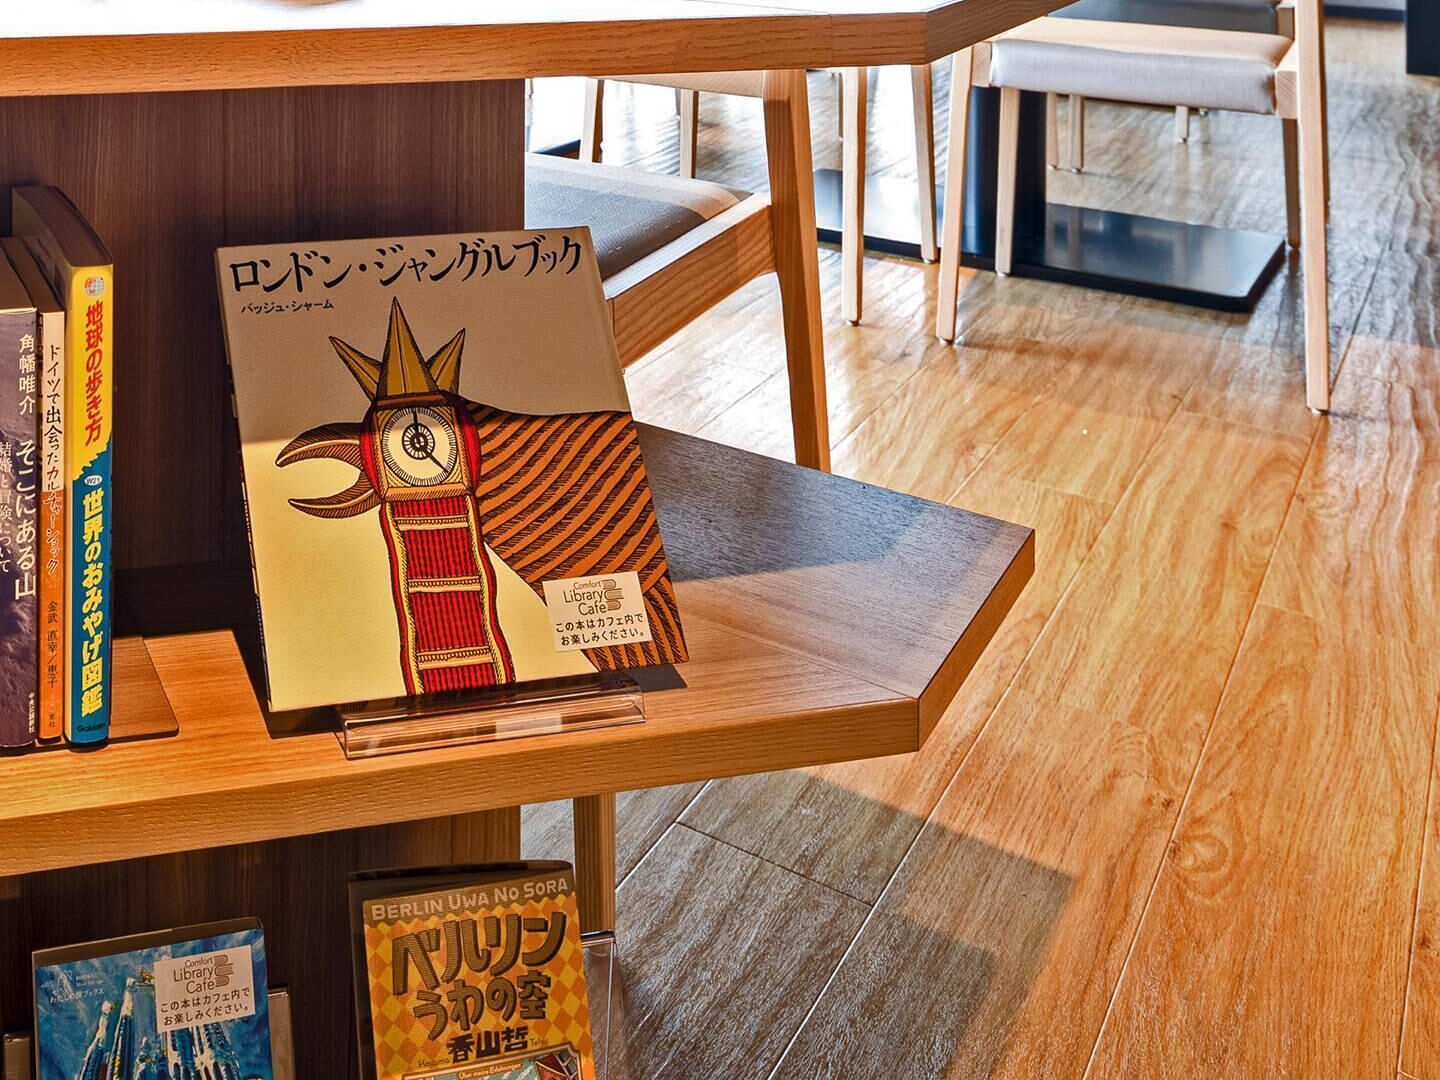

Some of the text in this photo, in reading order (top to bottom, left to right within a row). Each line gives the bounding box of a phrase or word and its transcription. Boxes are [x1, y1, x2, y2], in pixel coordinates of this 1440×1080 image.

[228, 234, 583, 293] ロンドン・ジャングルブック
[18, 333, 36, 416] 角幡唯介
[85, 299, 104, 446] 地球の歩き方
[44, 344, 63, 576] ドイツで出会ったカルチャーショック
[16, 440, 37, 601] そこにある山
[563, 589, 604, 603] Library
[573, 580, 601, 591] Comfort
[82, 486, 104, 718] 世界のおみやげ図鑑
[578, 600, 607, 616] Cafe
[555, 613, 643, 633] この本はカフェ内で
[560, 628, 644, 646] お楽しみください。
[371, 877, 569, 921] BERLIN UWA NO SORA
[184, 957, 214, 969] Comfort
[391, 911, 568, 997] ベルリン
[173, 966, 214, 983] Library
[186, 978, 215, 995] Cafe
[160, 987, 250, 1014] この本はカフェ内で
[163, 1004, 249, 1026] お楽しみください。
[413, 970, 552, 1042] うわの空
[446, 1026, 529, 1064] 香山哲
